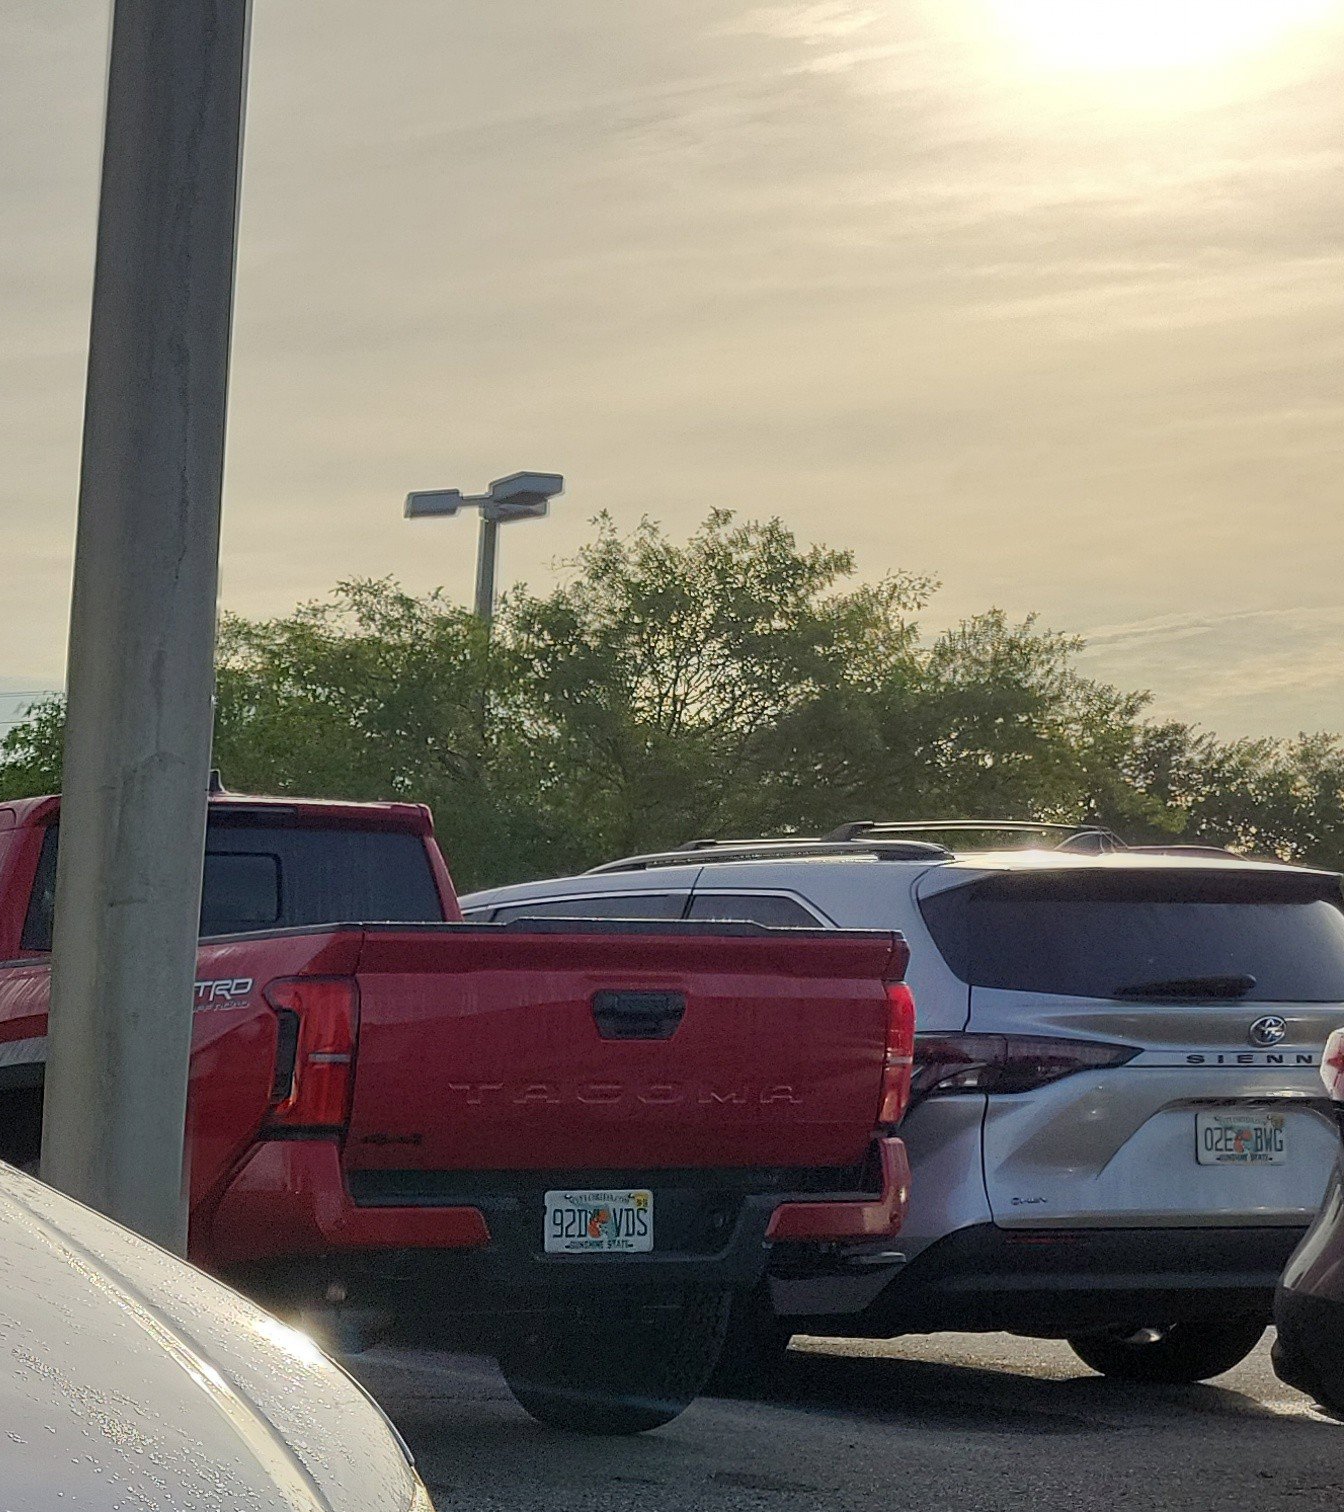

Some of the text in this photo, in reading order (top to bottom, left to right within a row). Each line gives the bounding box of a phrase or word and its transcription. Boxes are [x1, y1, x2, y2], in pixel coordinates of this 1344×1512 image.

[194, 978, 253, 1001] TRD
[1186, 1054, 1313, 1064] SIENN
[448, 1083, 803, 1104] TACOMA
[552, 1207, 648, 1238] 92D VDS
